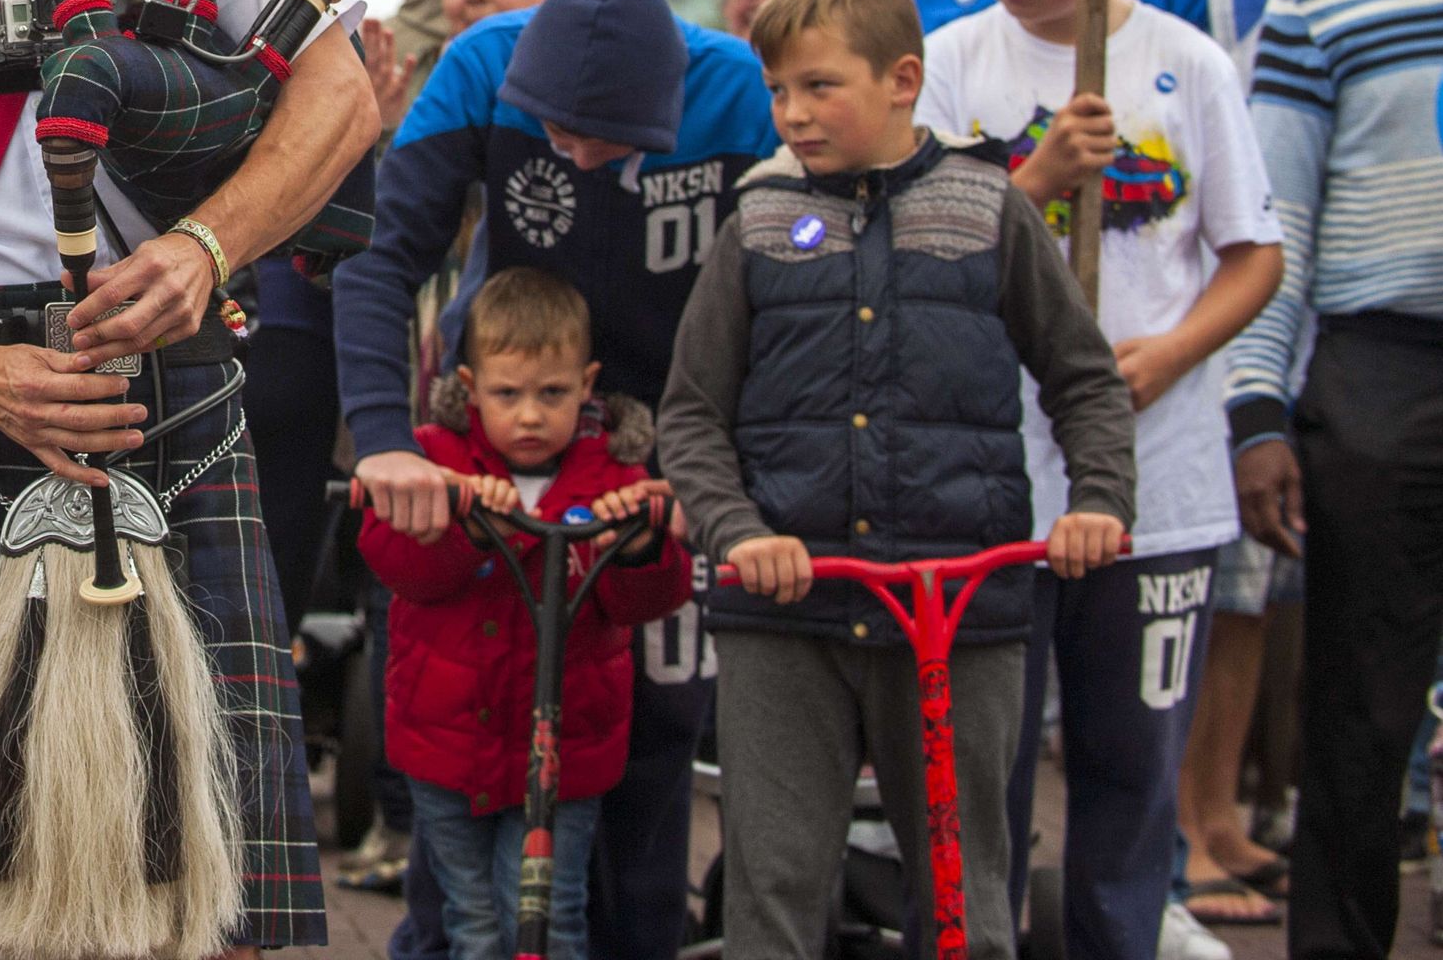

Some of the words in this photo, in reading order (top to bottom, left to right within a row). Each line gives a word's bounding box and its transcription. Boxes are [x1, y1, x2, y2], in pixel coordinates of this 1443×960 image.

[642, 160, 724, 207] NKSN
[645, 196, 717, 274] 01
[1137, 565, 1212, 614] NKSN
